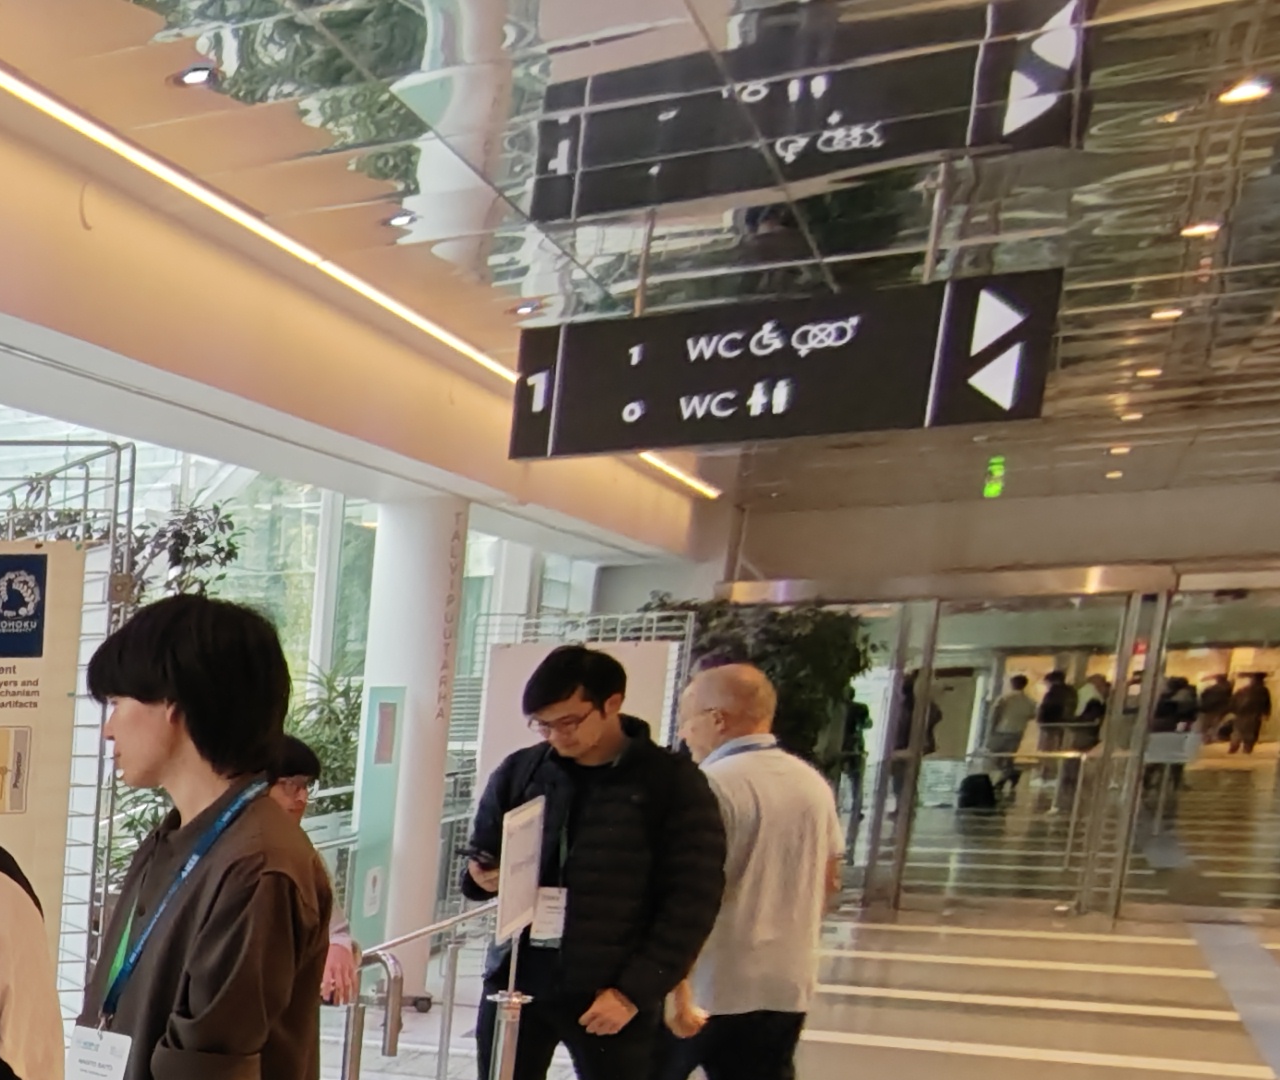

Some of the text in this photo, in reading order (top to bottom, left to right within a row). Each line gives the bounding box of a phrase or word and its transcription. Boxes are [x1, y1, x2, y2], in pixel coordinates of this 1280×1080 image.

[628, 331, 745, 366] 1 WC
[526, 369, 549, 413] 1
[679, 391, 737, 420] WC
[21, 678, 39, 686] and
[0, 700, 38, 708] artifacts
